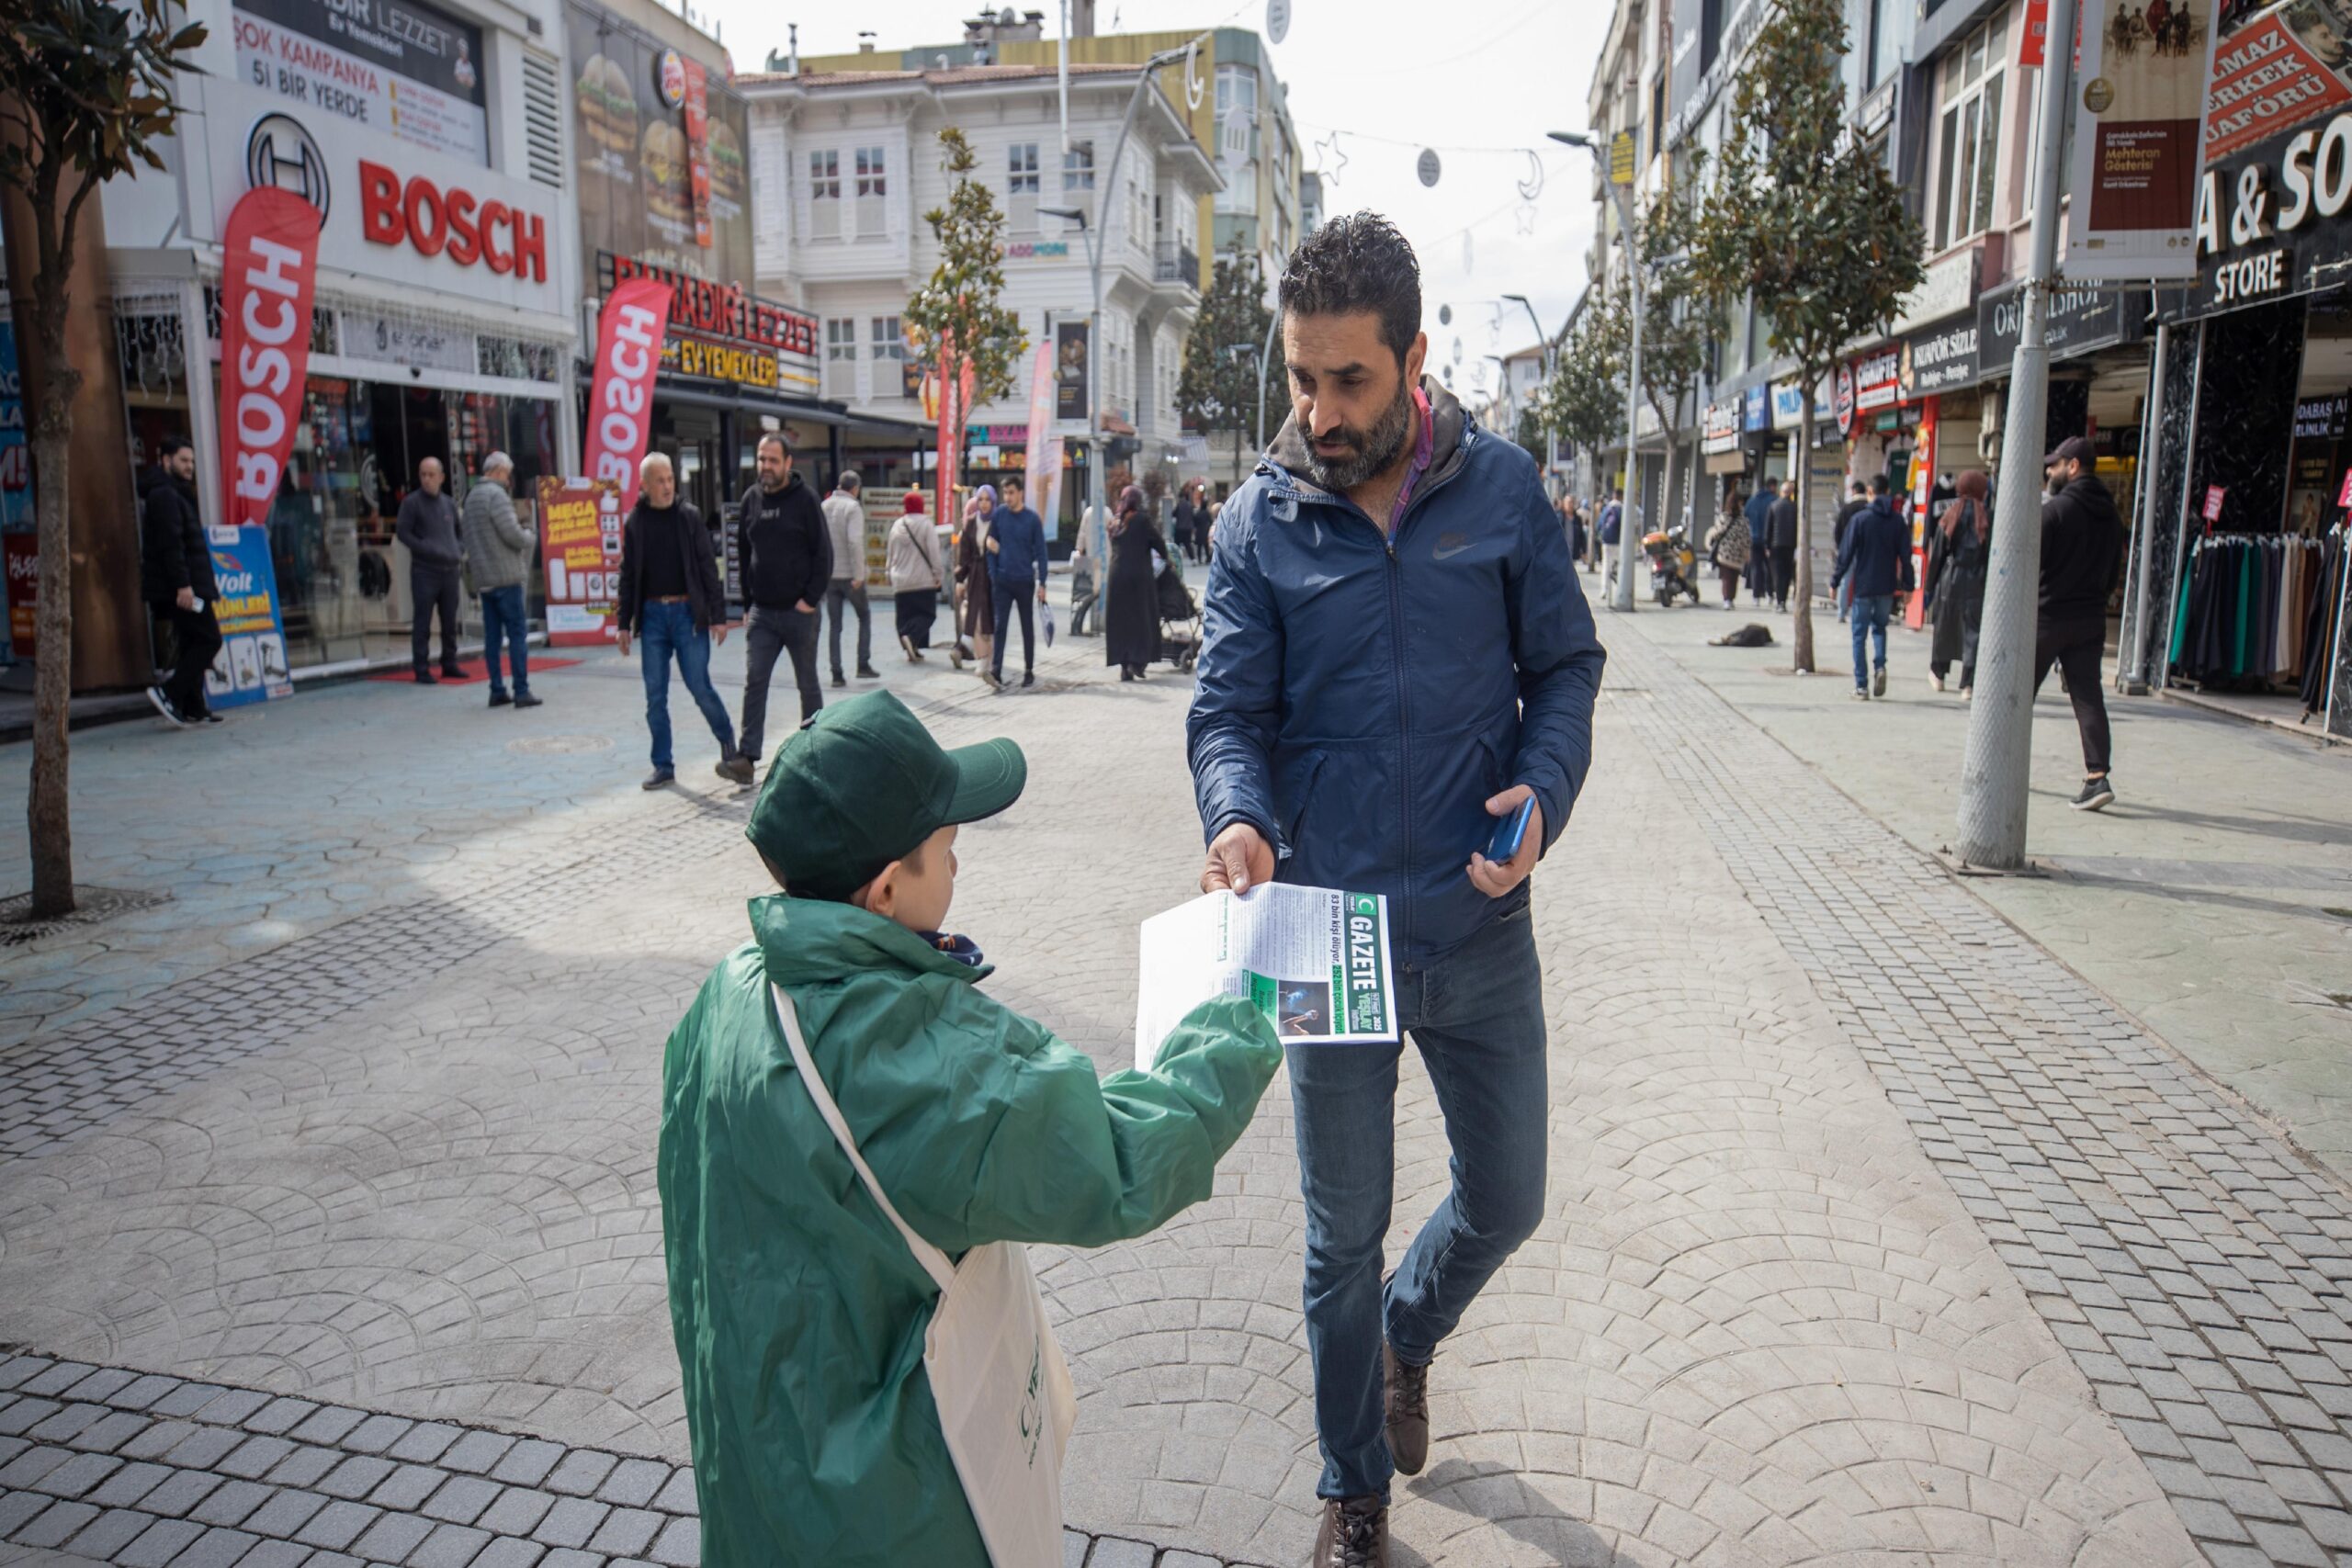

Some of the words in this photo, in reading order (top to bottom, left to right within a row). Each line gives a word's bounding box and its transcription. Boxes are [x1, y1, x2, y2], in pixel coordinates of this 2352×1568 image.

[376, 0, 451, 58] LEZZET
[278, 34, 380, 96] KAMPANYA
[278, 63, 309, 103] BİR
[312, 81, 368, 123] YERDE
[2206, 73, 2327, 143] UAFÖRÜ
[2104, 158, 2154, 172] Gösterisi
[2105, 146, 2162, 160] Mehteran
[358, 158, 548, 284] BOSCH
[2197, 171, 2222, 255] A
[2231, 164, 2269, 247] &
[2213, 249, 2284, 305] STORE
[743, 297, 818, 355] LEZZET
[235, 235, 302, 502] BOSCH
[214, 571, 254, 595] Volt
[1330, 894, 1340, 905] 83
[1330, 906, 1340, 919] bin
[1329, 920, 1341, 935] kişi
[1330, 937, 1342, 964] ölüyor,
[1350, 916, 1377, 991] GAZETE
[1332, 965, 1342, 979] 252
[1333, 980, 1343, 991] bin
[1331, 993, 1344, 1012] çocuk
[1332, 1013, 1345, 1034] içiyor!
